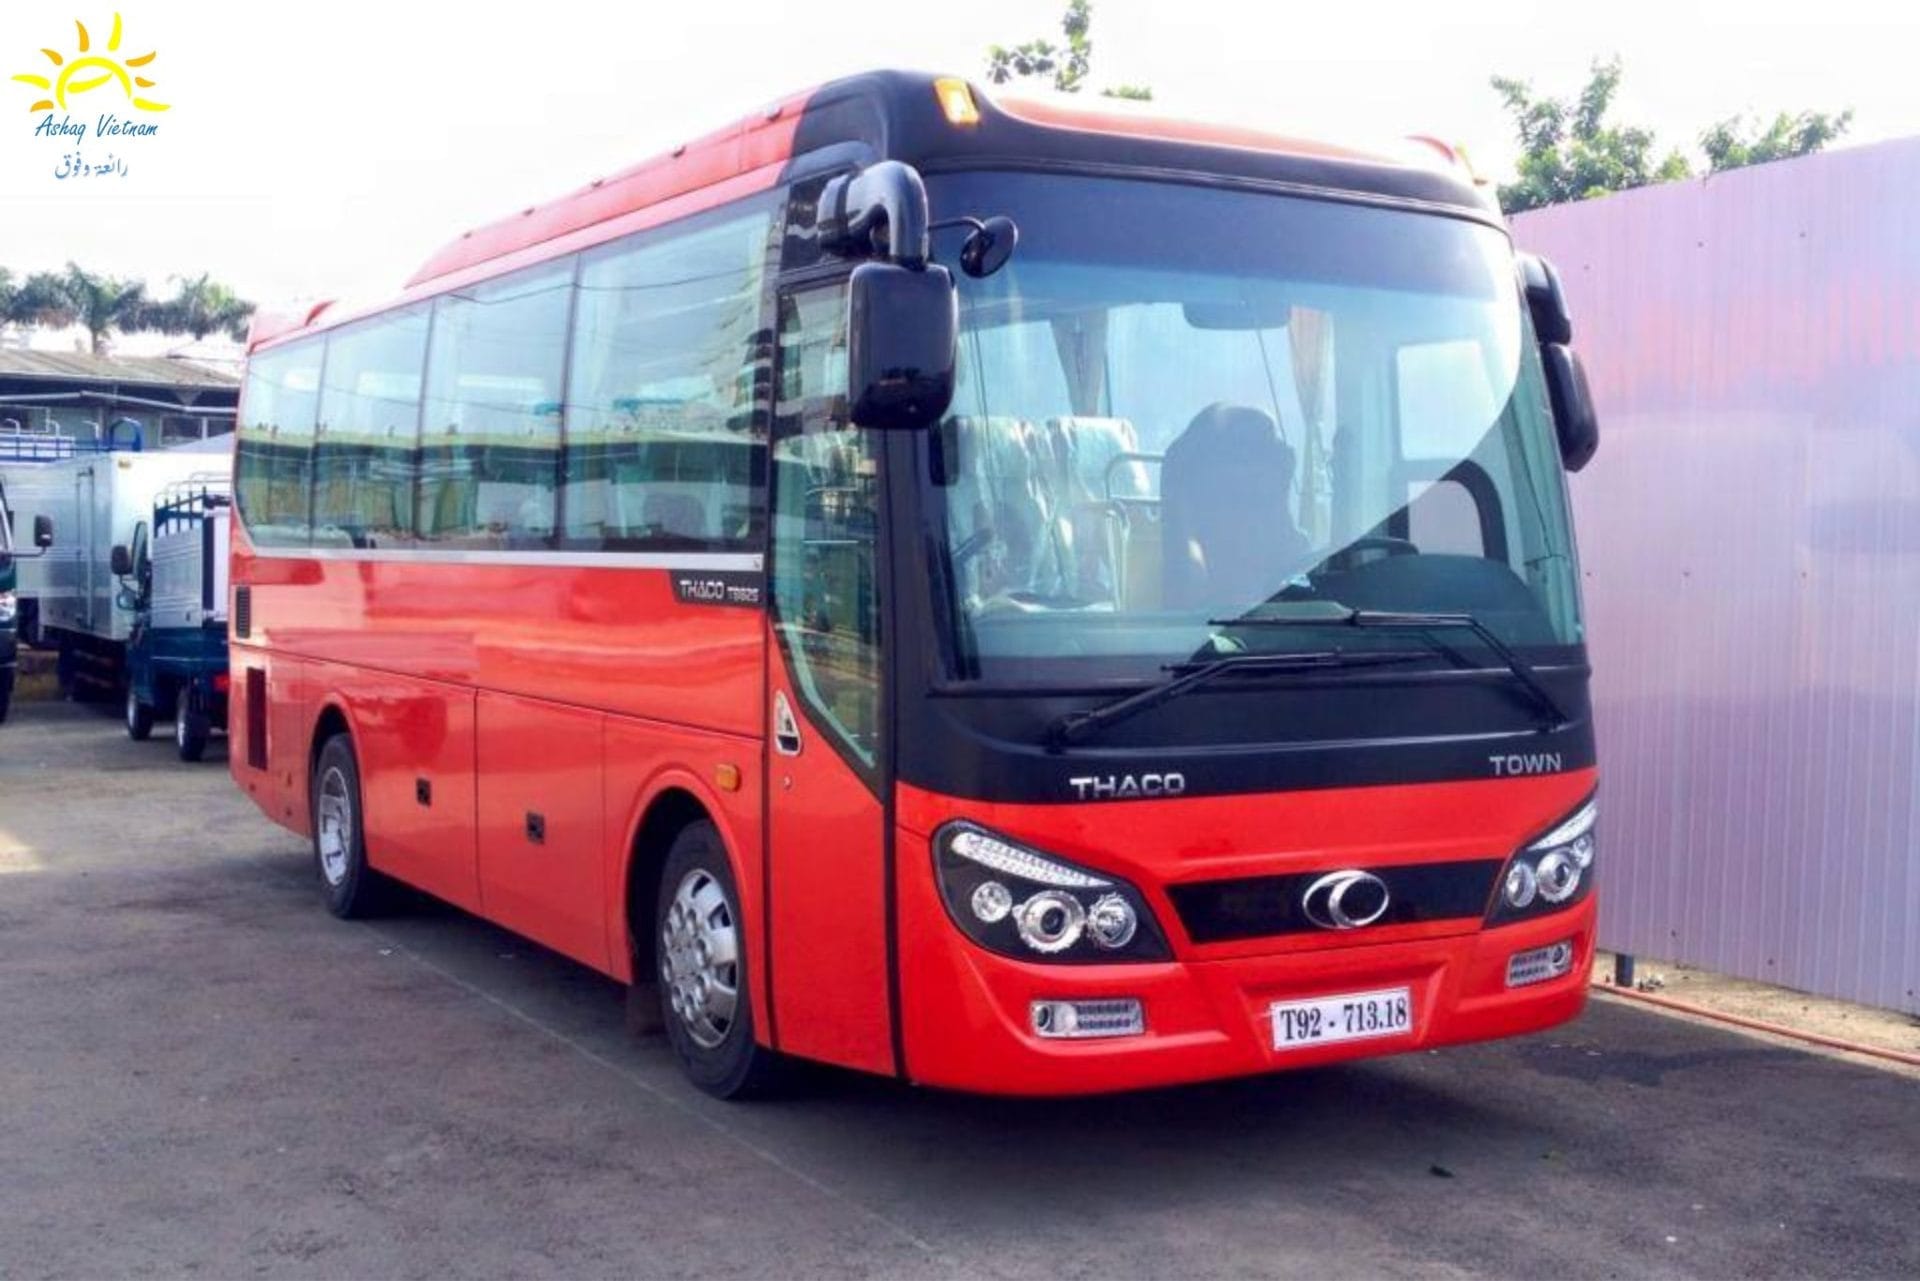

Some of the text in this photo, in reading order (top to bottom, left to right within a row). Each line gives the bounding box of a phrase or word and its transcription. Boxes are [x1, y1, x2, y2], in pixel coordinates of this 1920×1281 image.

[679, 580, 724, 599] THACO
[1489, 753, 1562, 776] TOWN
[1069, 773, 1185, 799] THACO
[1280, 1007, 1321, 1040] T92
[1343, 997, 1407, 1033] 713.18
